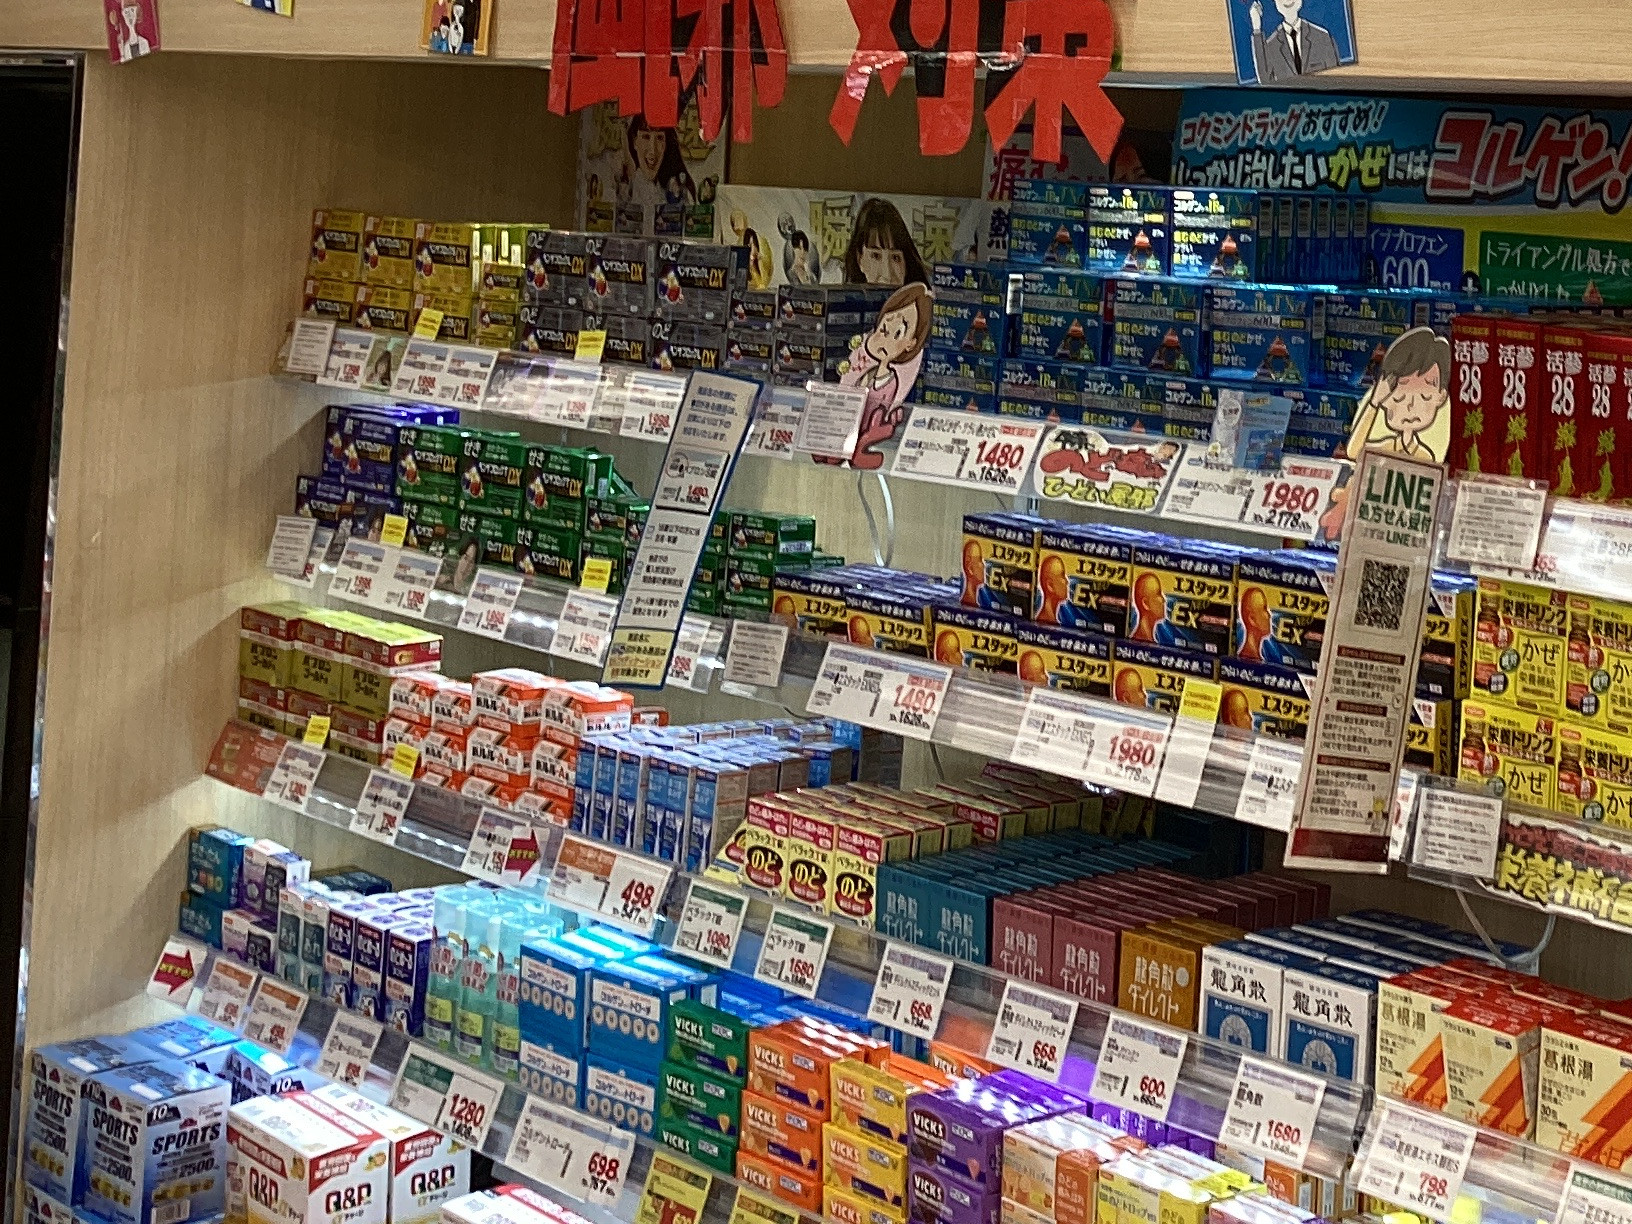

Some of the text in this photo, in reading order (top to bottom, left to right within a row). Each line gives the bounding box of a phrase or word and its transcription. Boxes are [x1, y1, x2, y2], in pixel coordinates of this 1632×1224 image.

[1503, 368, 1525, 410] 28
[1592, 383, 1610, 418] 28
[1366, 465, 1434, 512] LINE
[1076, 558, 1128, 582] エスタック
[1173, 576, 1230, 600] エスタック
[804, 598, 847, 618] エスタック
[879, 620, 923, 641] エスタック
[1055, 654, 1107, 678] エスタック
[1487, 723, 1554, 752] 栄養ドリンク
[1507, 763, 1546, 795] かぜ
[794, 863, 827, 888] のど
[840, 875, 873, 900] のど
[621, 879, 654, 908] 498
[1210, 966, 1268, 1005] 龍角散
[910, 999, 932, 1019] 668
[1380, 999, 1426, 1034] 葛根湯
[1033, 1039, 1057, 1061] 668
[1543, 1049, 1594, 1082] 葛根湯
[666, 1073, 696, 1097] VICKS
[1140, 1076, 1164, 1097] 600
[33, 1080, 73, 1117] SPORTS
[92, 1107, 139, 1145] SPORTS
[746, 1103, 777, 1126] VICKS
[151, 1122, 220, 1154] SPORTS
[662, 1128, 690, 1153] VICKS
[829, 1137, 860, 1161] VICKS
[588, 1151, 620, 1180] 698
[741, 1163, 772, 1185] VICKS
[912, 1173, 945, 1204] VICKS
[1419, 1171, 1447, 1196] 798
[829, 1199, 863, 1223] VICKS
